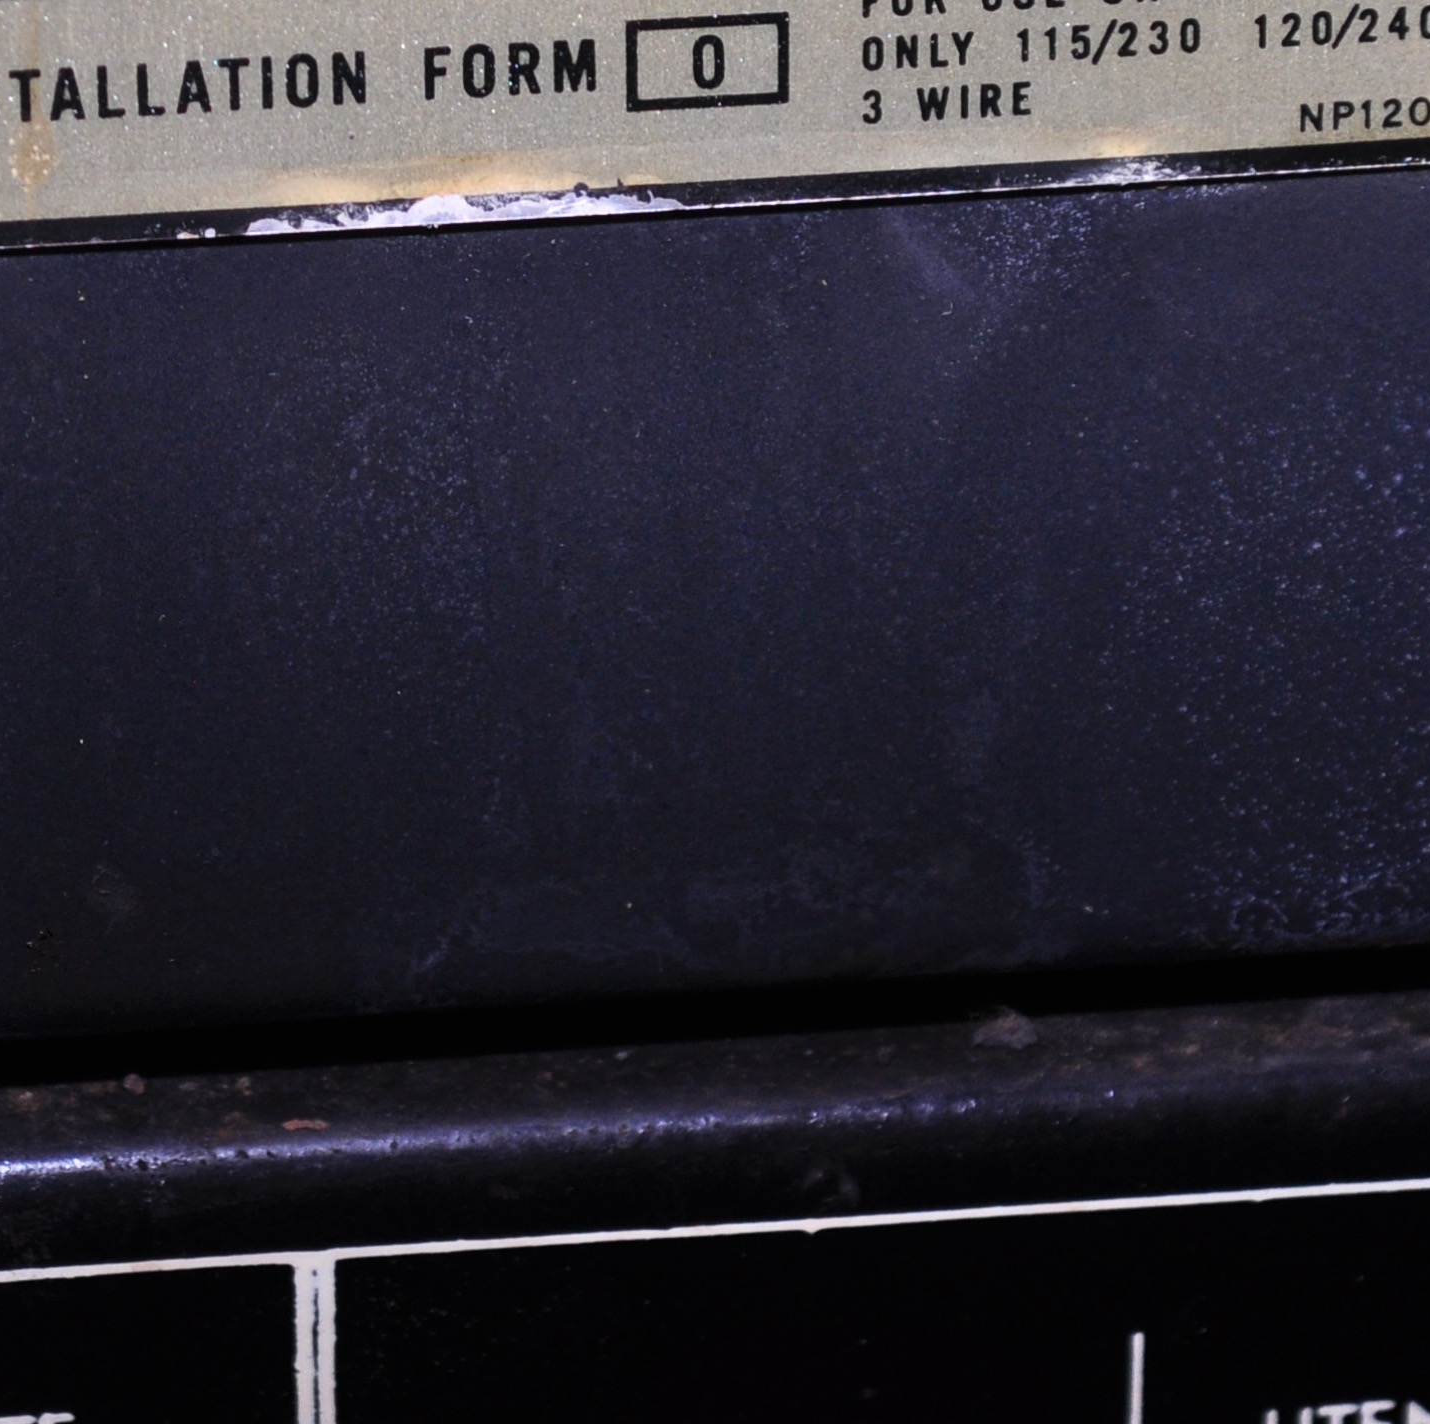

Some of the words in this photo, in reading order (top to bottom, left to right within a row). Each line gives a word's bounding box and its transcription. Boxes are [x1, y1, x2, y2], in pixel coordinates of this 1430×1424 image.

[423, 39, 599, 102] FORM
[861, 30, 975, 72] ONLY
[1016, 18, 1202, 66] 115/230
[861, 88, 883, 125] 3
[916, 81, 1033, 122] WIRE
